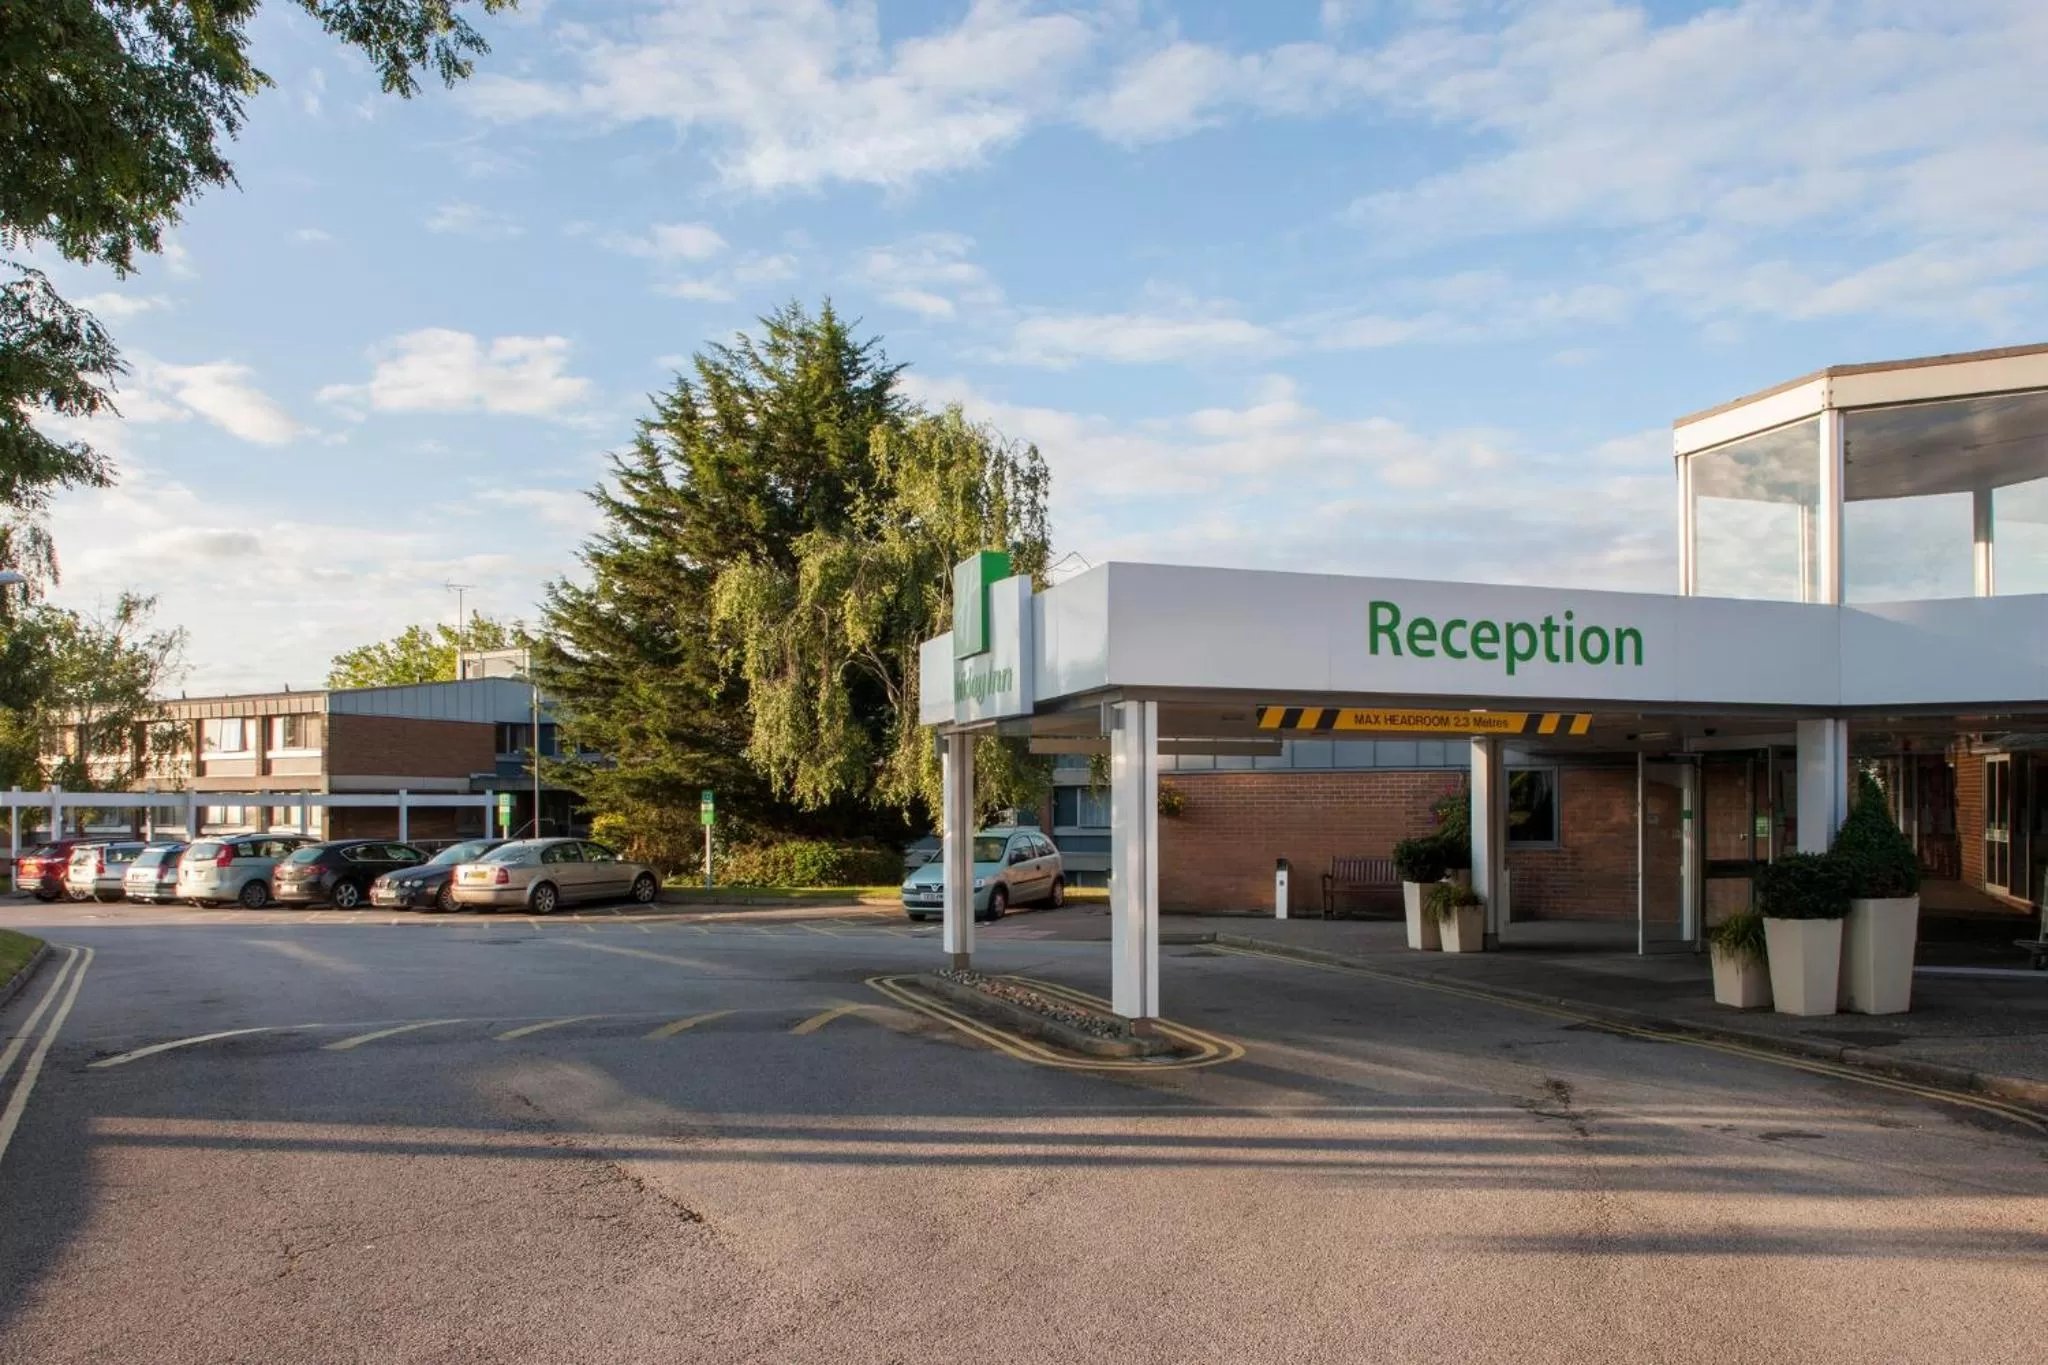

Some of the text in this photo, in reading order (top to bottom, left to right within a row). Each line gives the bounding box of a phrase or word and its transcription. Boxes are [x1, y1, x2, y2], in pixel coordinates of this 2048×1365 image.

[1368, 600, 1643, 676] Reception
[987, 667, 1012, 696] Inn
[1353, 713, 1381, 725] MAX
[1384, 714, 1450, 727] HEADROOM
[1473, 717, 1509, 728] Metres
